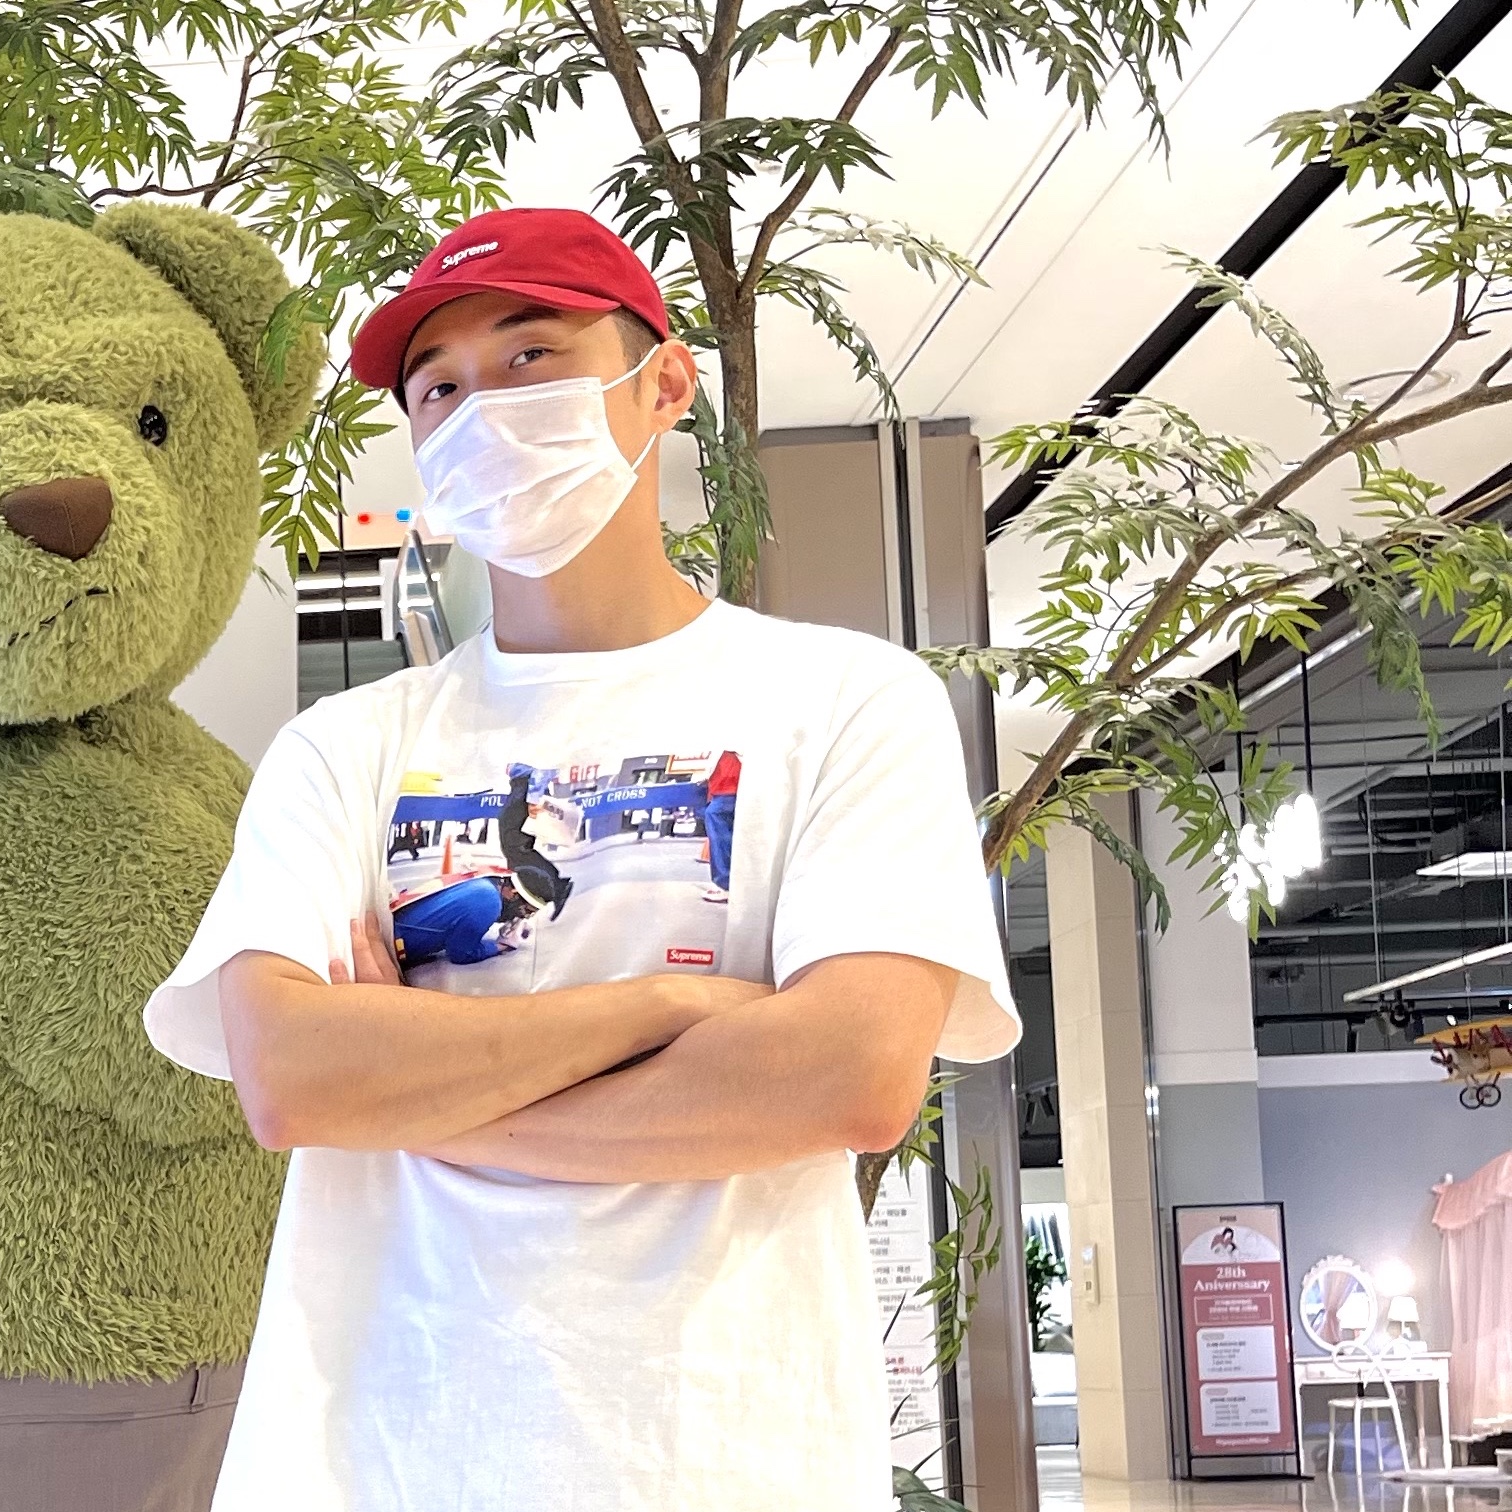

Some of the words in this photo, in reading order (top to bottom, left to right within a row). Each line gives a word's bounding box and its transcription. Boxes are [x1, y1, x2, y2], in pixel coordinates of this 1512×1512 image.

[441, 241, 499, 270] Supreme
[570, 764, 601, 783] GIFT
[607, 788, 647, 803] CROSS
[670, 949, 711, 963] Supreme
